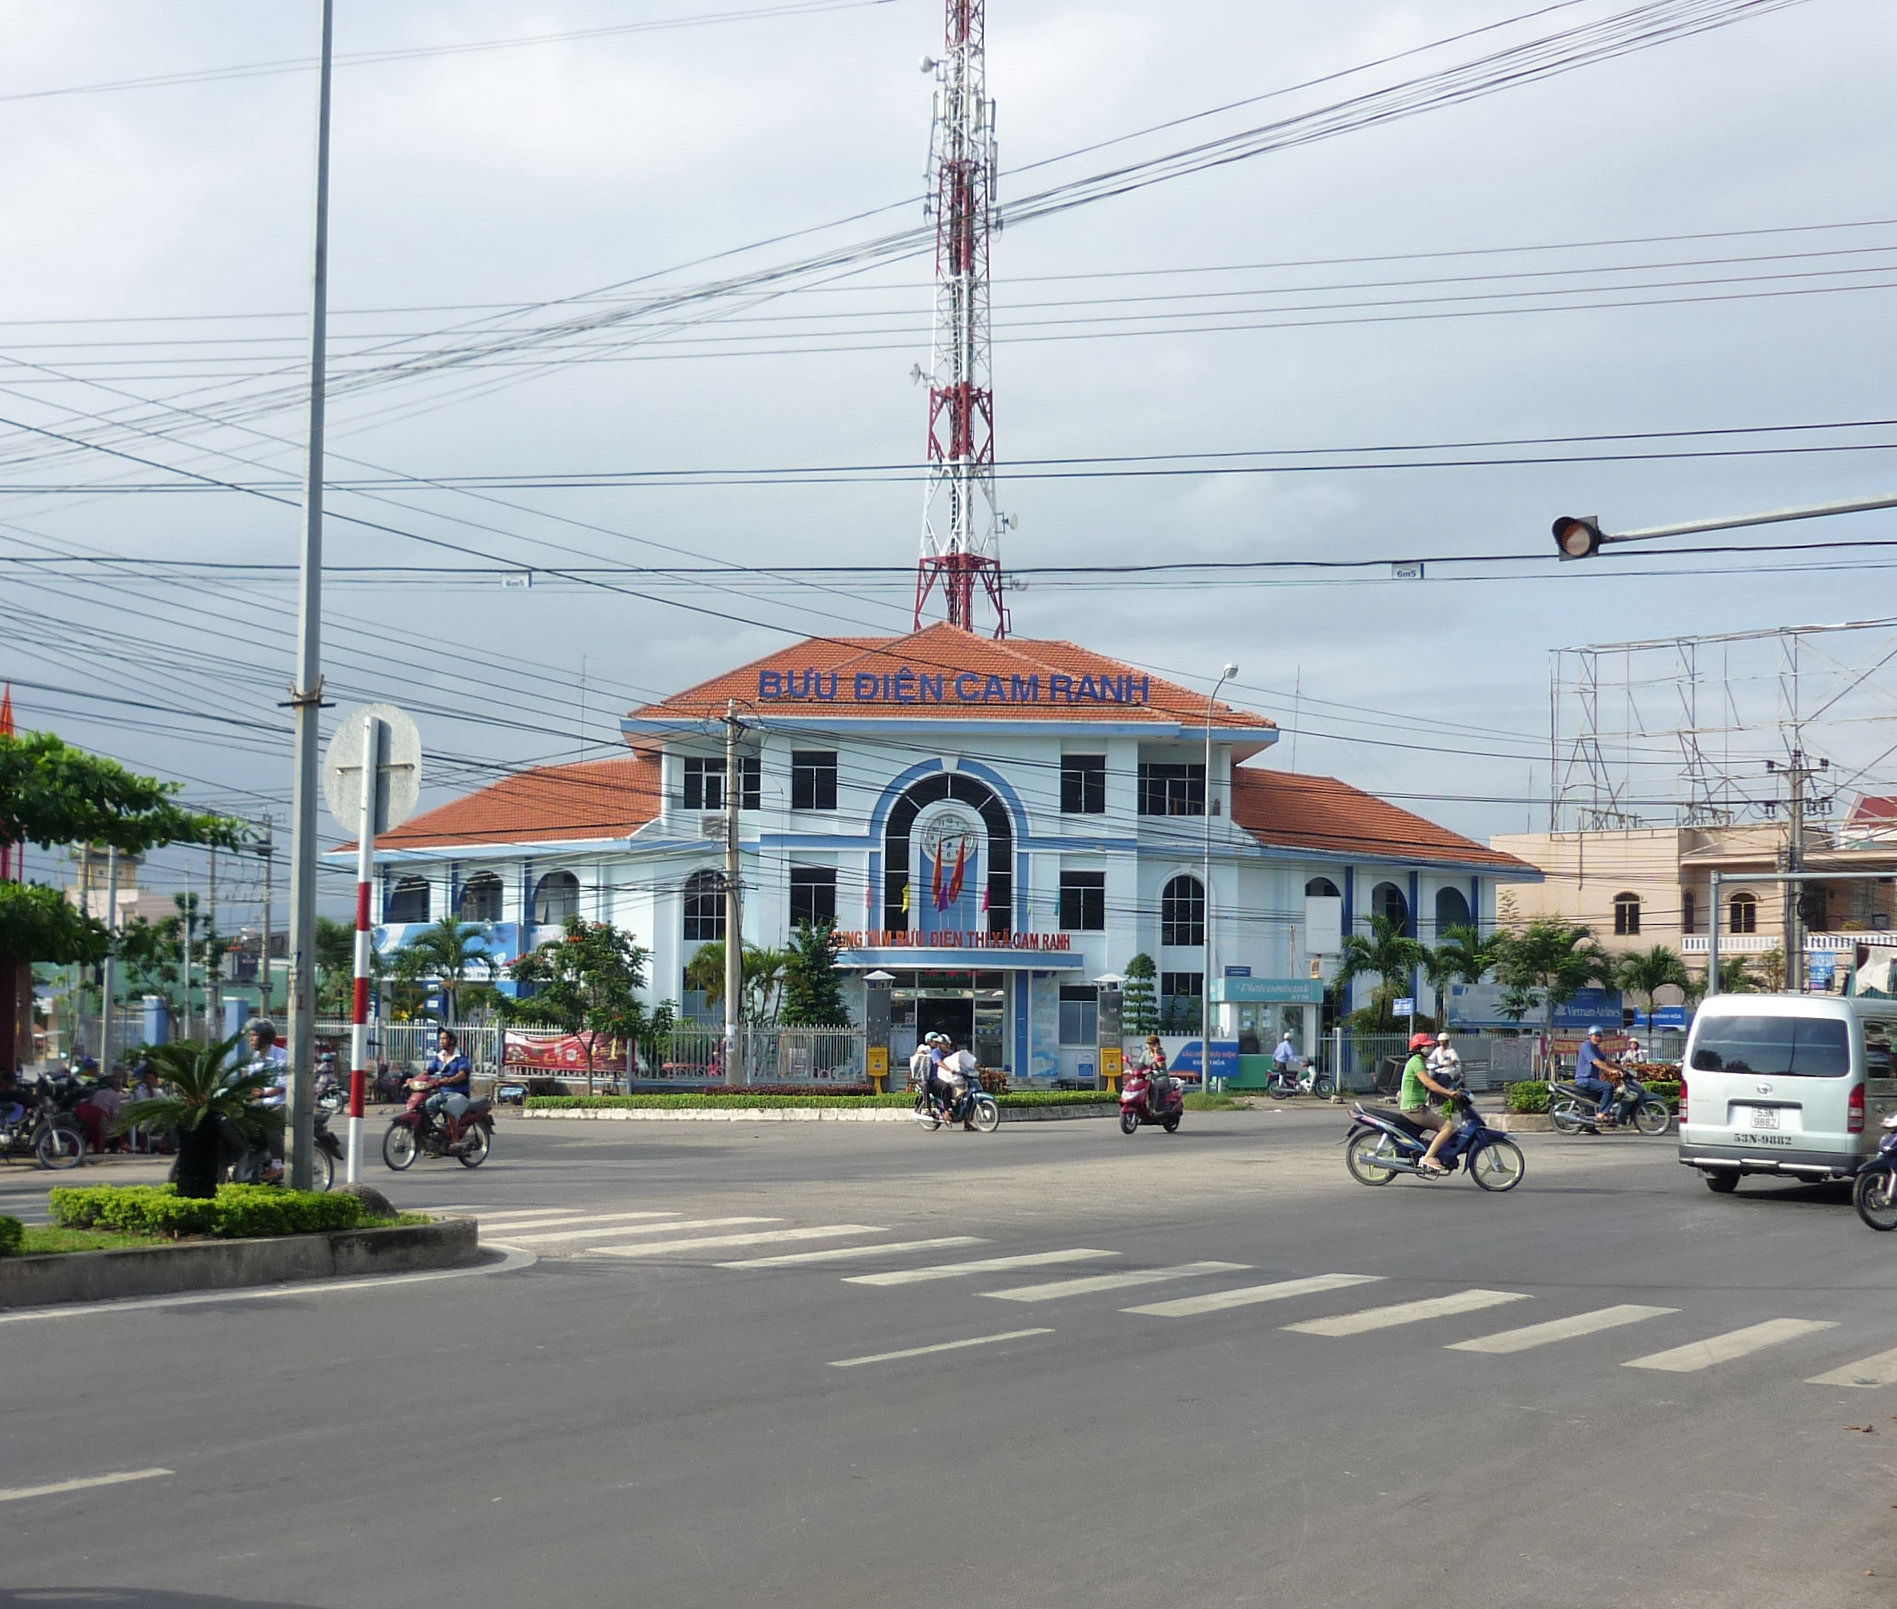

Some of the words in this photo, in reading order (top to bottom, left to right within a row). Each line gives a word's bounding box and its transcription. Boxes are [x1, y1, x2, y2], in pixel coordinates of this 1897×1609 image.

[758, 666, 839, 700] BƯU
[853, 666, 943, 705] ĐIỆN
[955, 673, 1040, 701] CAM
[1049, 674, 1150, 703] RANH
[1012, 931, 1039, 949] CAM
[1042, 933, 1070, 951] RANH
[1566, 1006, 1595, 1017] Vietnam
[1595, 1006, 1621, 1017] Airlines
[1756, 1108, 1775, 1118] 53N
[1753, 1117, 1777, 1127] 9882
[1733, 1133, 1793, 1146] 53N-9882
